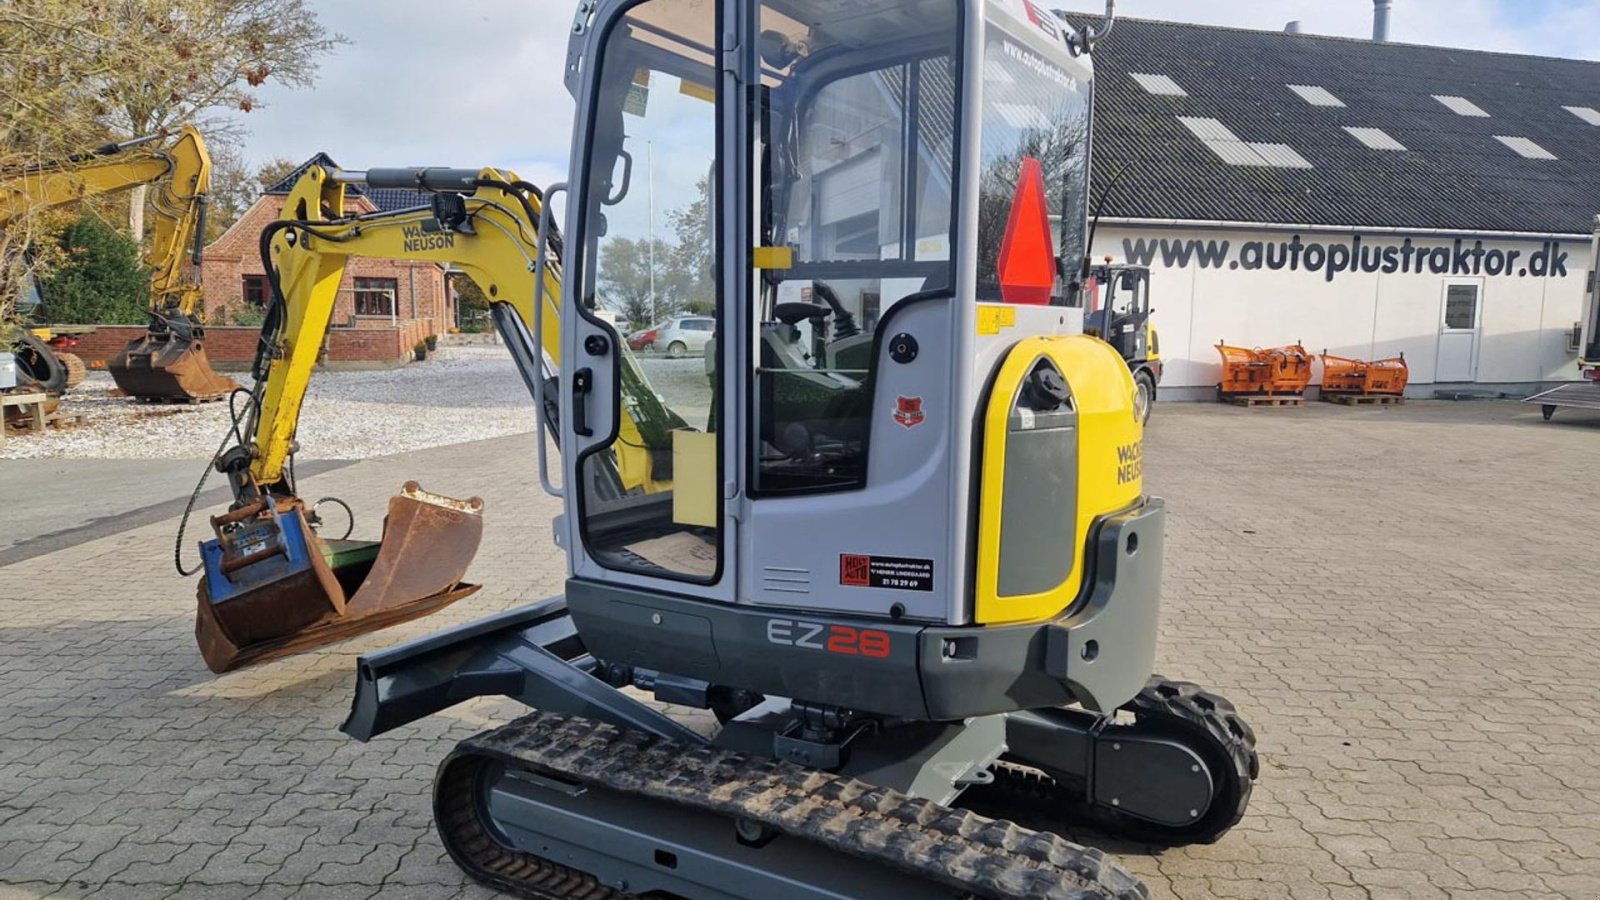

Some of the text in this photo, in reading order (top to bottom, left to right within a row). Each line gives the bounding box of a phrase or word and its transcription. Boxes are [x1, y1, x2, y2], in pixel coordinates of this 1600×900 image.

[404, 236, 454, 252] NEUSON
[1122, 234, 1568, 281] www.autoplustraktor.dk
[767, 619, 890, 658] EZ28
